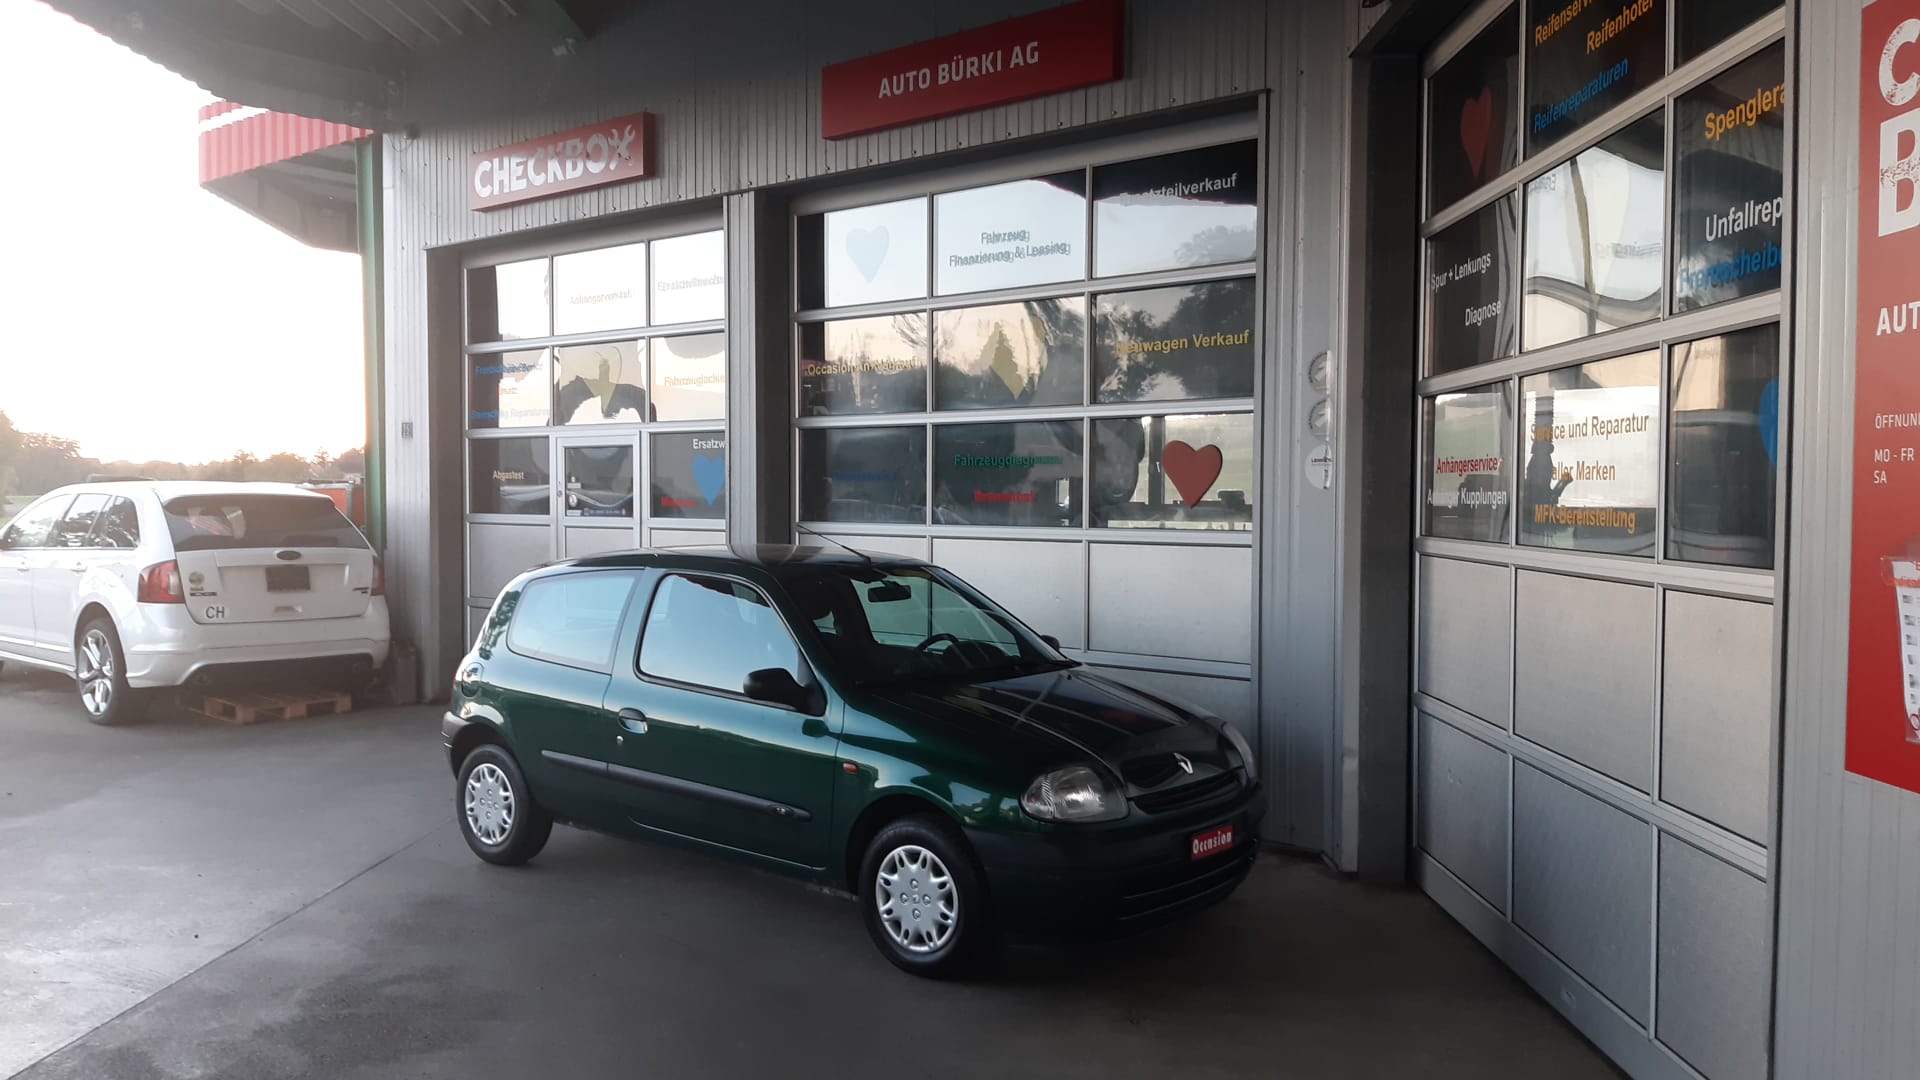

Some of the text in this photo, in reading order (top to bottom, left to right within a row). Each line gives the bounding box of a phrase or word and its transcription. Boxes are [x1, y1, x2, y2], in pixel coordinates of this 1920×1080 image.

[1535, 0, 1593, 47] Reifenser
[878, 41, 1039, 99] AUTO BÜRKI AG
[1534, 57, 1628, 133] Reifenreparaturen
[949, 250, 1015, 267] Finanzierung
[1026, 241, 1071, 257] Leasing
[1431, 271, 1448, 293] Spur
[1454, 252, 1491, 281] Lenkungs
[1465, 300, 1502, 327] Diagnose
[1192, 329, 1250, 348] Verkauf
[1568, 417, 1588, 438] und
[1591, 412, 1650, 440] Reparatur
[1875, 413, 1920, 429] ÖFFNUN
[1874, 449, 1890, 463] MO
[1901, 448, 1915, 461] FR
[1576, 460, 1616, 481] Marken
[1873, 470, 1888, 484] SA
[1461, 487, 1507, 509] Kupplungen
[205, 606, 225, 619] CH
[1192, 830, 1232, 854] Occasion
